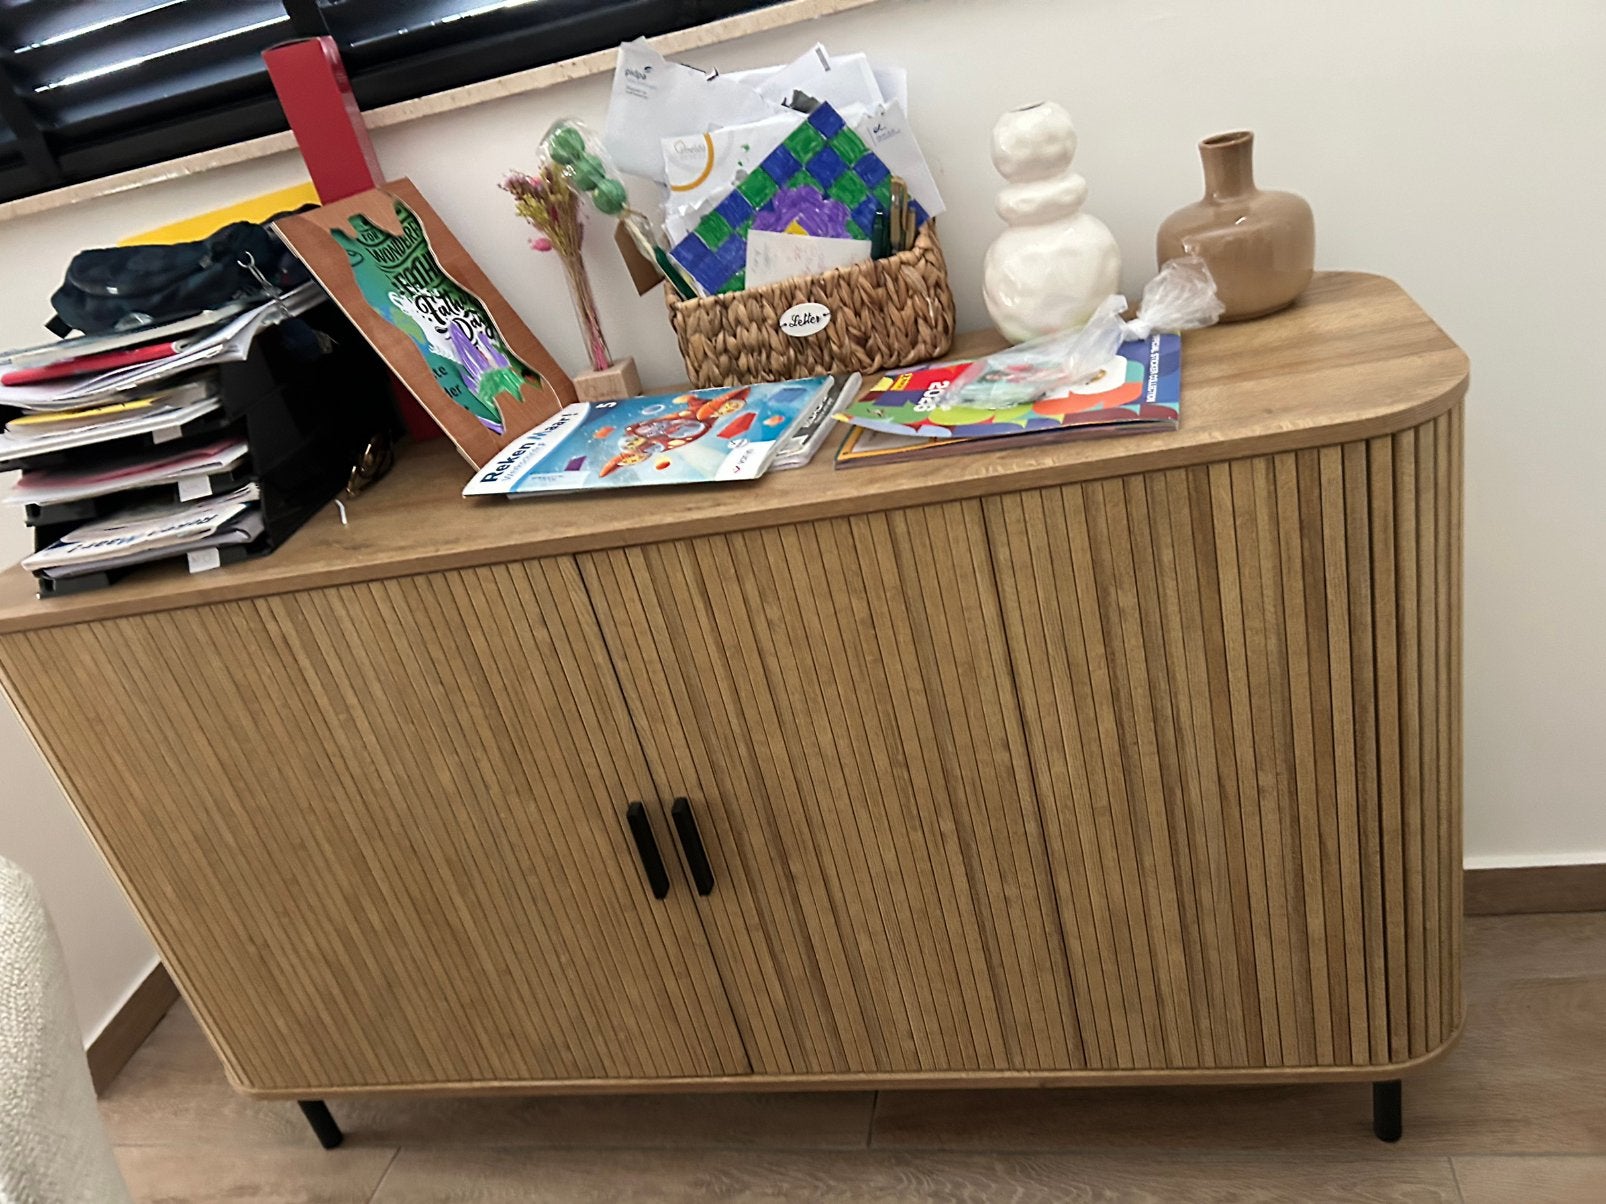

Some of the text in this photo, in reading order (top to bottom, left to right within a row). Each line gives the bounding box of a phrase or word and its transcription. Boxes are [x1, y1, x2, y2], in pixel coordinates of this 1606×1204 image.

[365, 220, 422, 263] WONDERF
[788, 312, 821, 328] Letter
[480, 442, 535, 483] Reken
